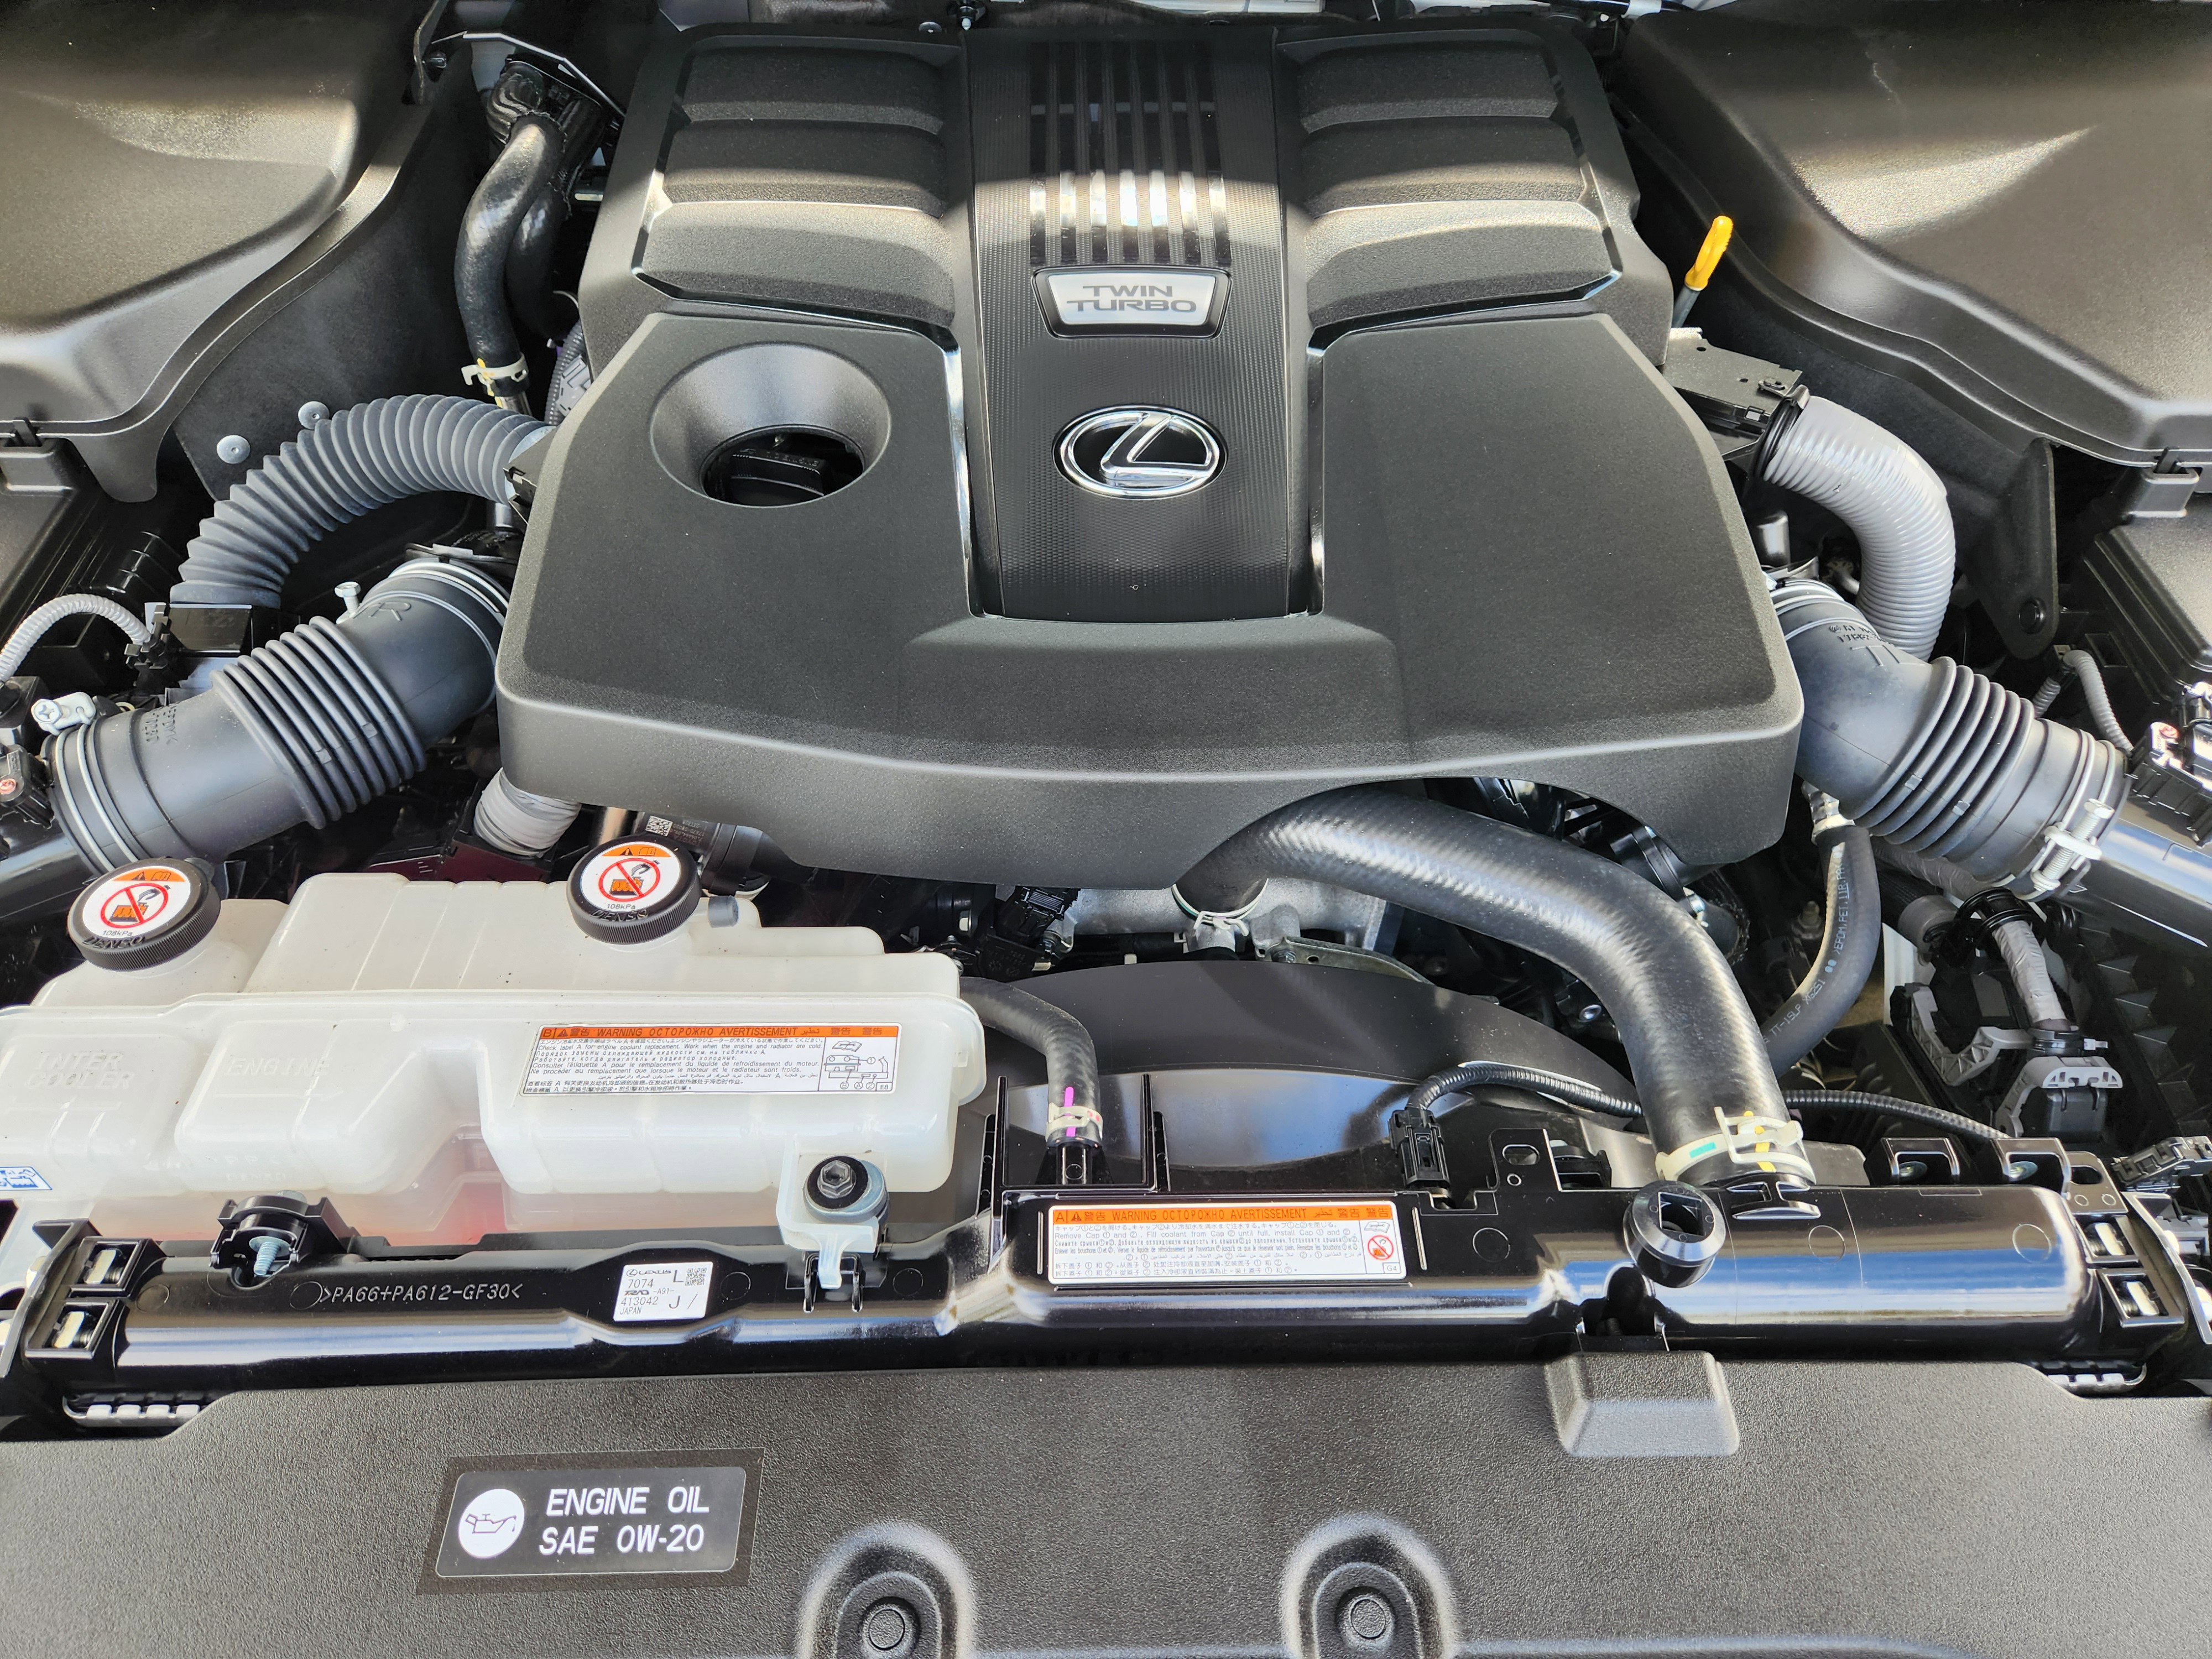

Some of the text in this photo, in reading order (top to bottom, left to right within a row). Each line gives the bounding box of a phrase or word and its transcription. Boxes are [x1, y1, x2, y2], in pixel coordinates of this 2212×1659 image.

[1082, 285, 1172, 298] TWIN
[1067, 299, 1197, 312] TURBO
[596, 1028, 643, 1037] WARNING
[718, 1027, 799, 1037] AVERTISSEMENT
[36, 1052, 123, 1071] INTER
[222, 1056, 333, 1076] ENGINE
[25, 1072, 132, 1089] COOLER
[1112, 1211, 1156, 1221] WARNING
[1230, 1208, 1307, 1219] AVERTISSEMENT
[628, 1279, 654, 1288] 7074
[620, 1296, 659, 1306] 413042
[669, 1295, 681, 1310] J
[620, 1306, 642, 1315] JAPAN
[545, 1485, 710, 1517] ENGINE OIL
[539, 1524, 705, 1556] SAE 0W-20
